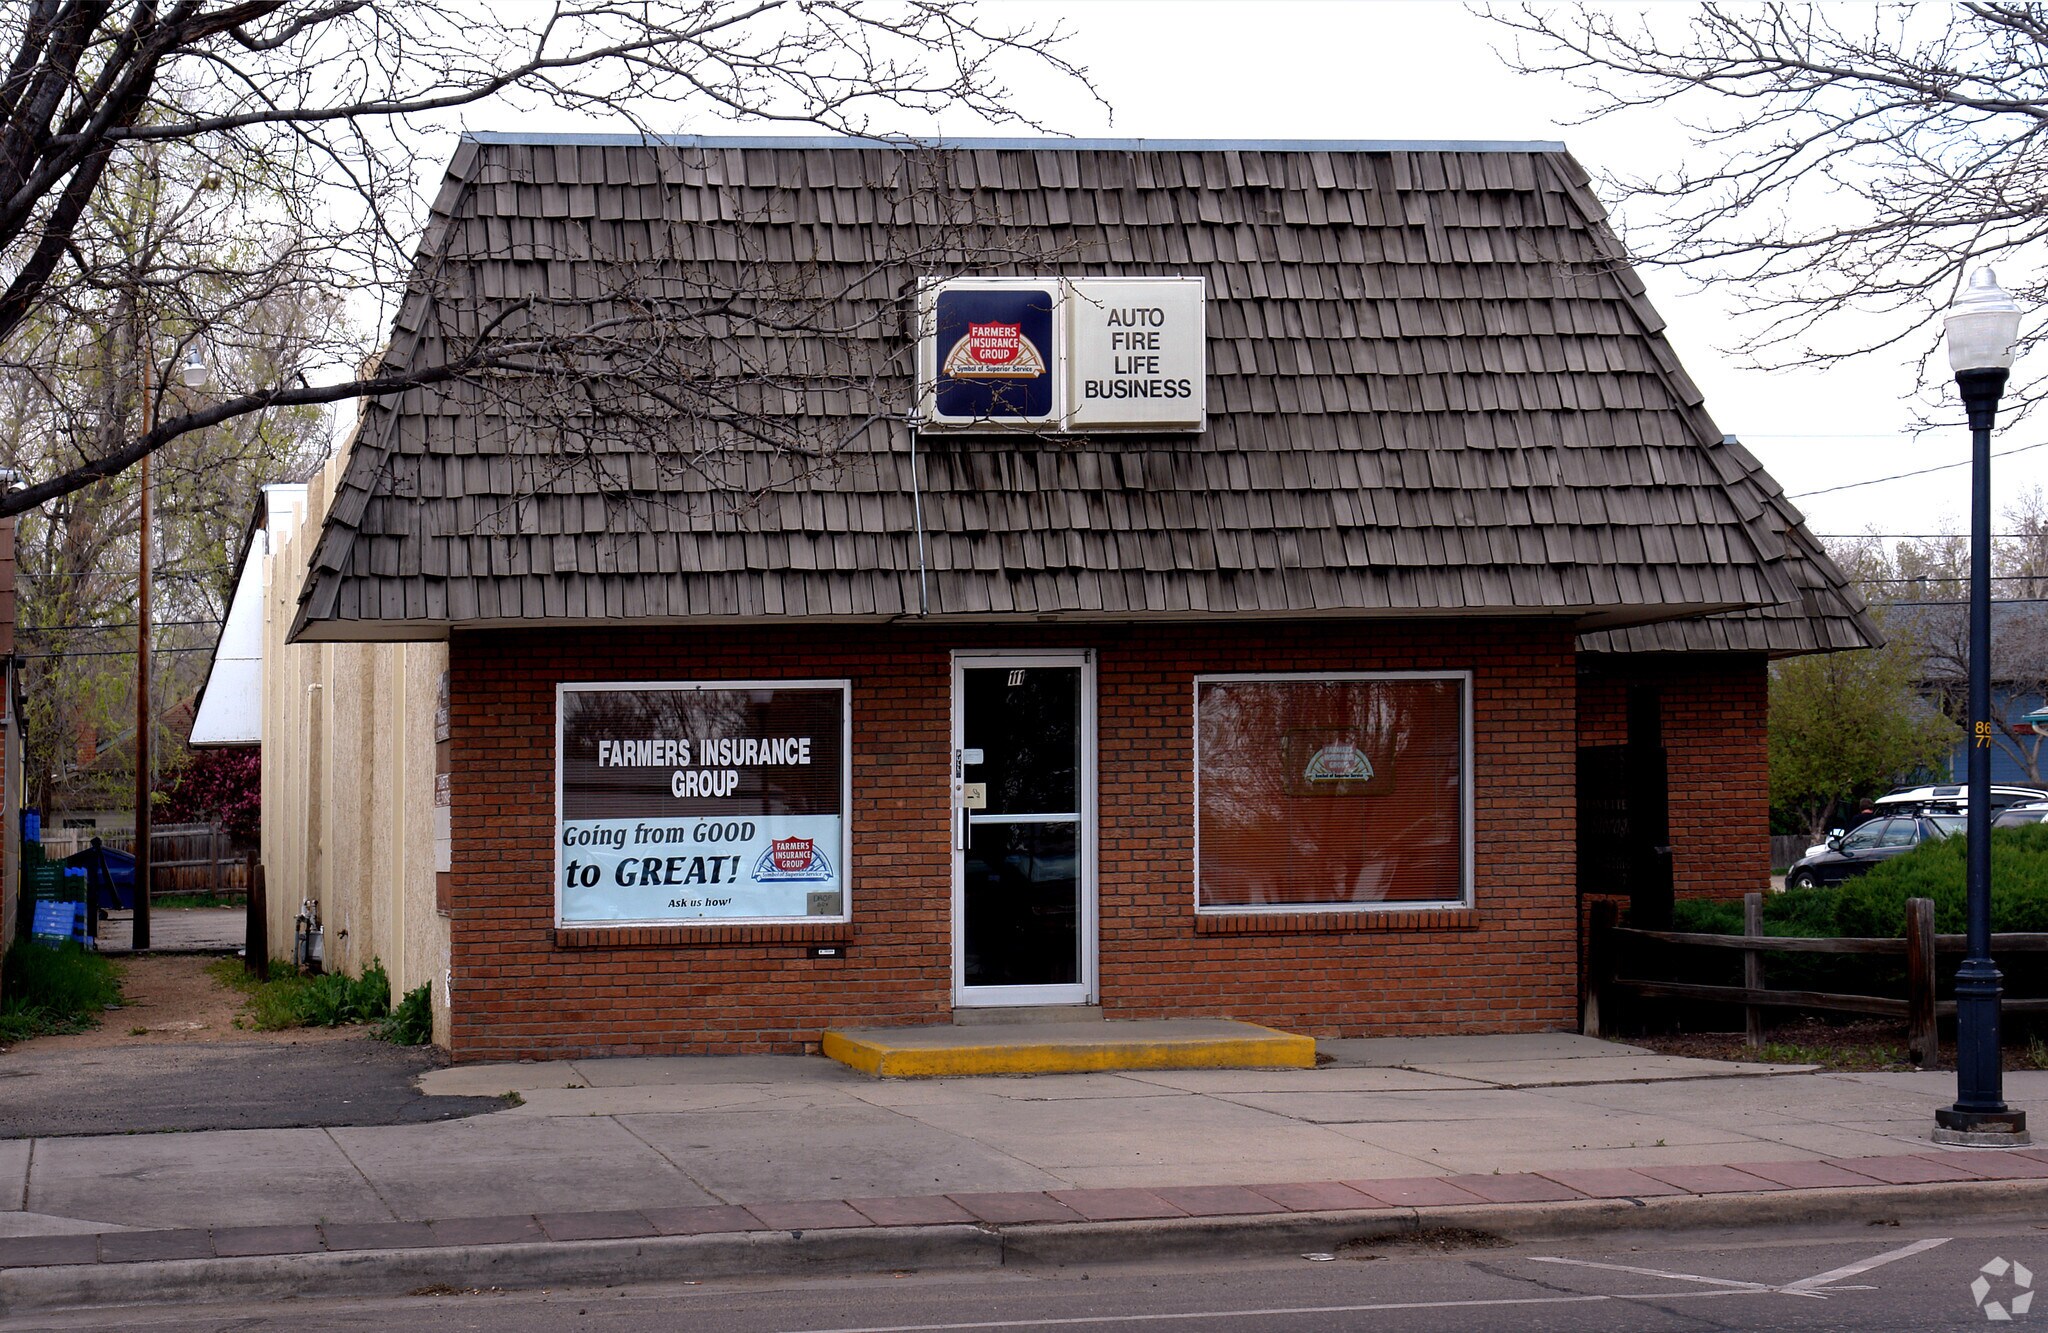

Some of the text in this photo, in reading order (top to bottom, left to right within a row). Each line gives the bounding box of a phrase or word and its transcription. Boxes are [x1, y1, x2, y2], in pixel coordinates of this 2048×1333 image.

[1107, 307, 1165, 327] AUTO
[972, 326, 1018, 338] FARMERS
[970, 337, 1020, 349] INSURANCE
[1112, 332, 1160, 351] FIRE
[979, 349, 1011, 360] GROUP
[956, 365, 977, 373] Symbol
[985, 365, 1011, 373] Superior
[1114, 355, 1160, 375] LIFE
[1085, 379, 1192, 399] BUSINESS
[1008, 669, 1025, 686] 111
[1975, 721, 1991, 735] 86
[1975, 735, 1991, 748] 77
[598, 737, 811, 767] FARMERS INSURANCE
[671, 770, 739, 798] GROUP
[563, 821, 756, 850] Going from GOOD
[777, 842, 810, 850] FARMERS
[775, 851, 811, 859] INSURANCE
[781, 860, 804, 868] GROUP
[566, 855, 742, 888] to GREAT!
[668, 897, 732, 908] Ask us how!
